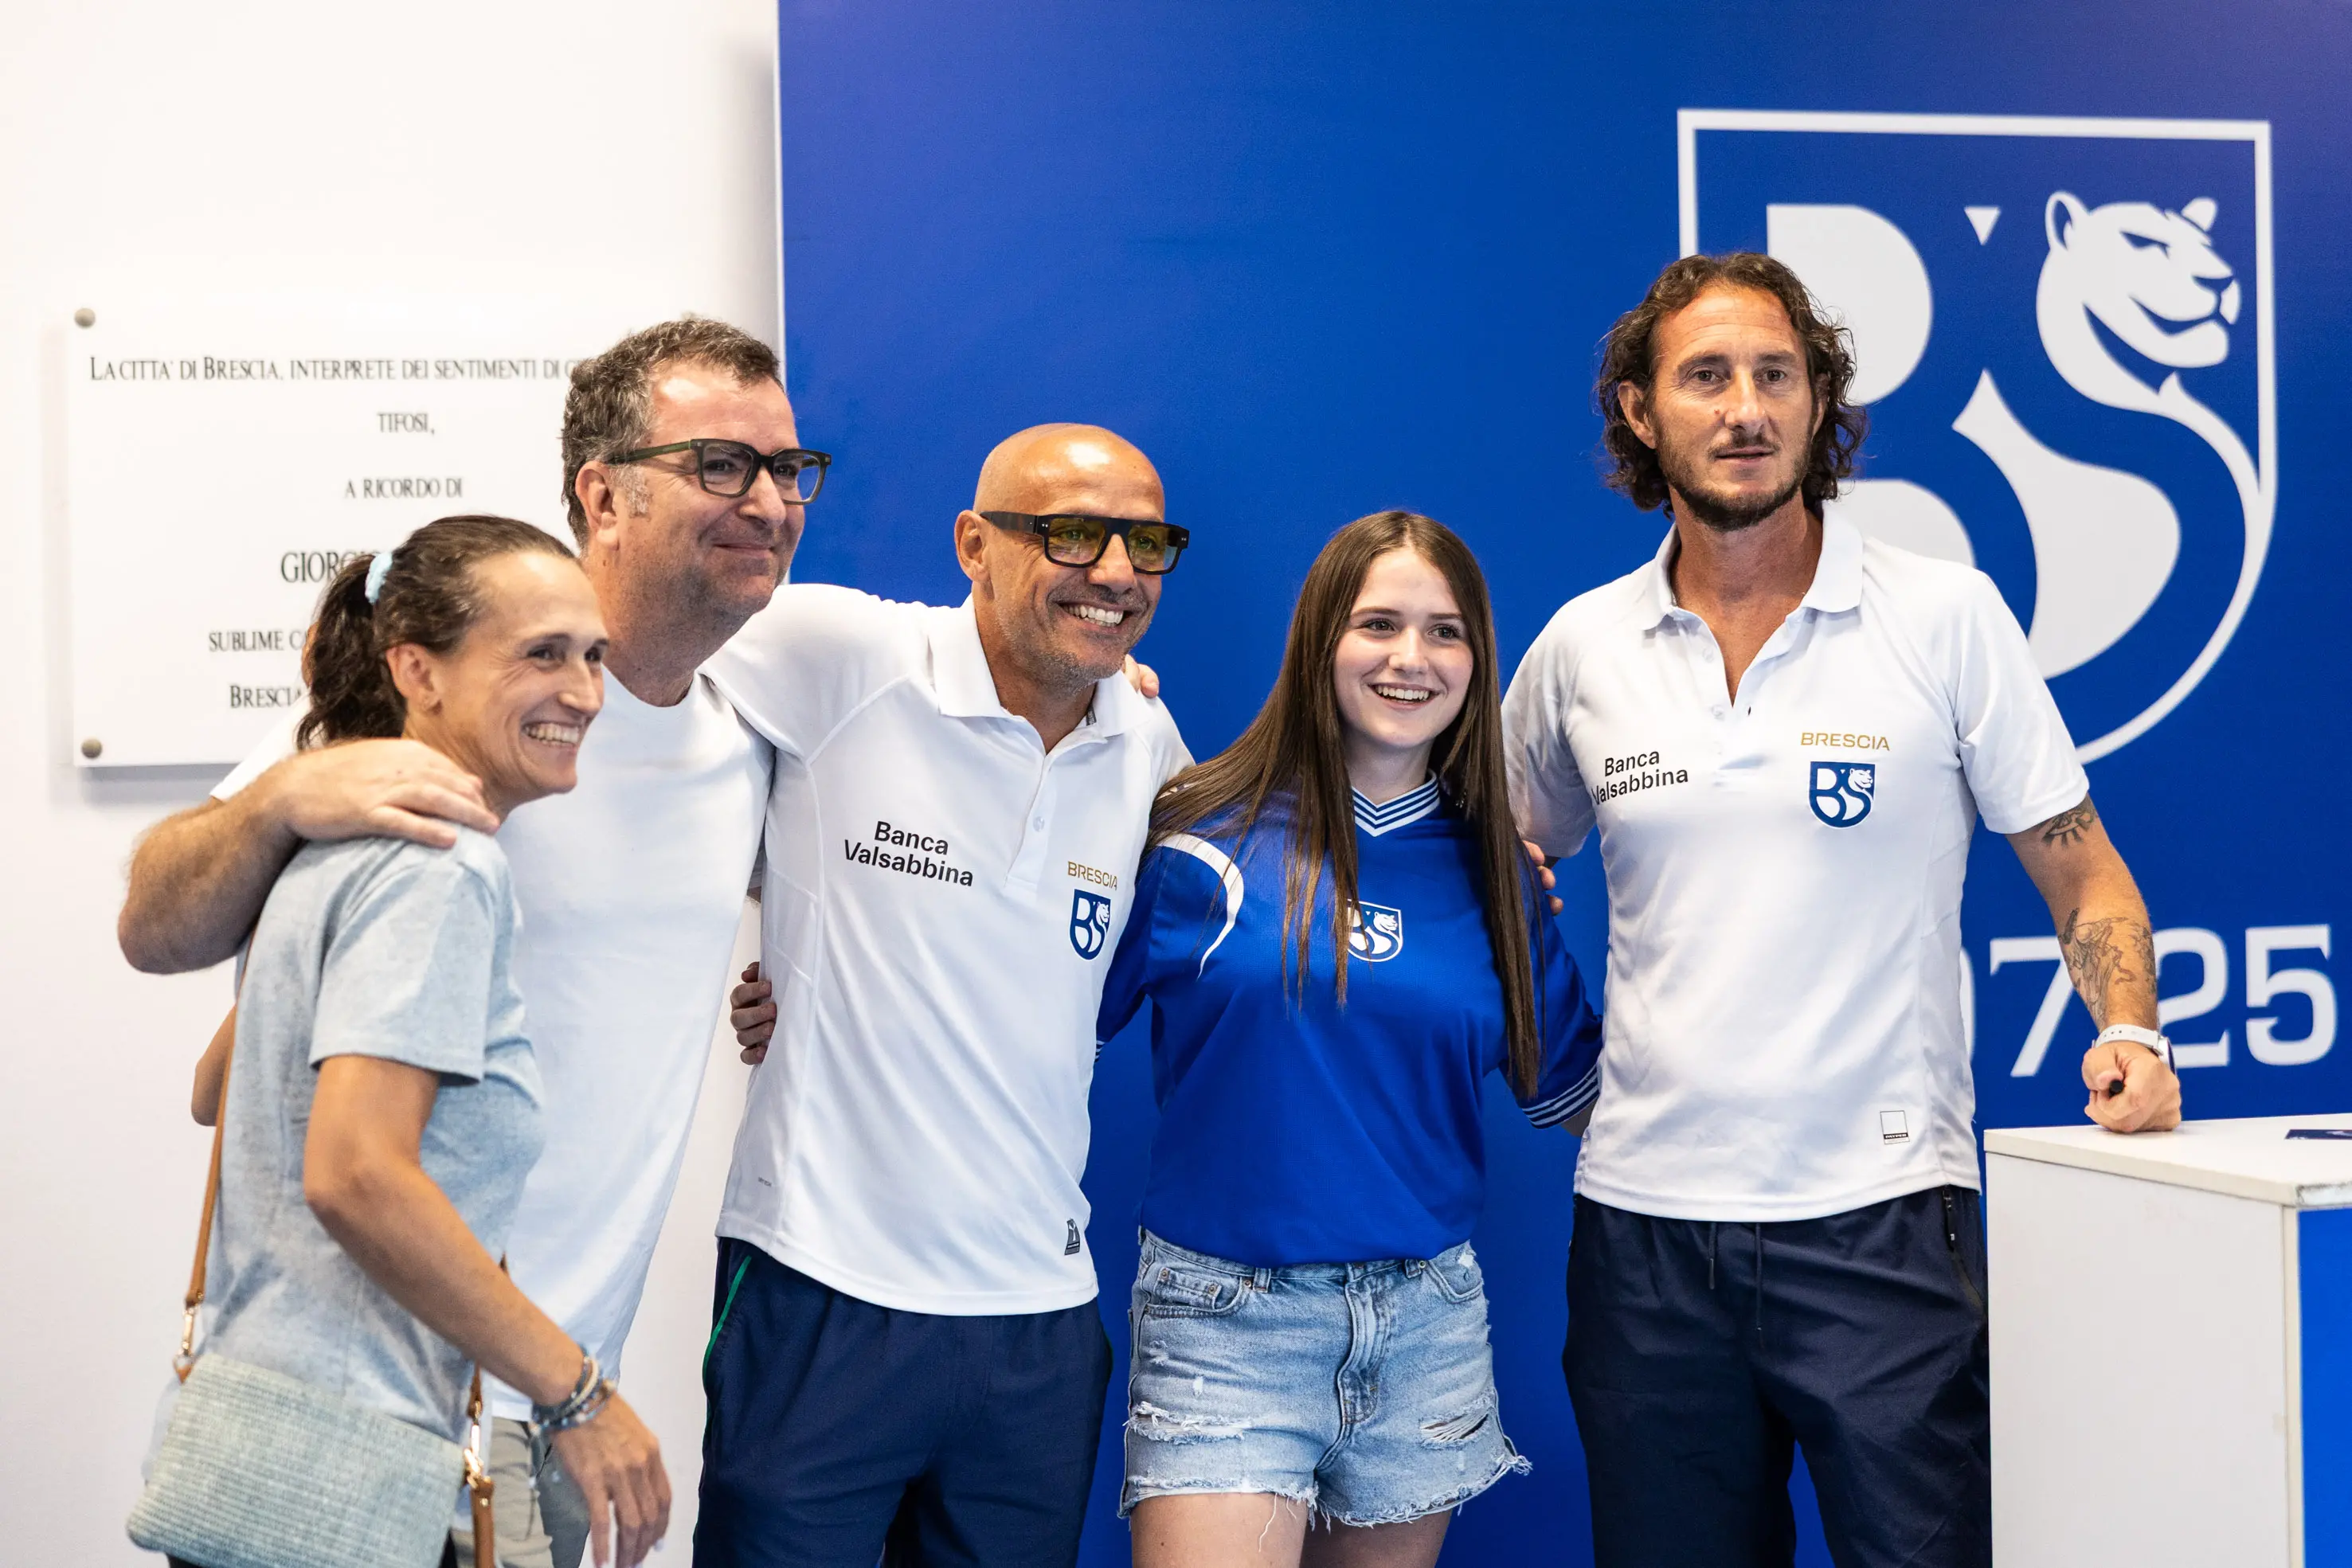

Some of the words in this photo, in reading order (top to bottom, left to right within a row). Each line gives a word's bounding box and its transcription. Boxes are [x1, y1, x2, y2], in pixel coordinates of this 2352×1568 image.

[90, 356, 116, 380] LA
[180, 360, 197, 380] DI
[290, 359, 396, 380] INTERPRETE
[401, 360, 429, 380] DEI
[434, 360, 536, 380] SENTIMENTI
[543, 359, 560, 380] DI
[377, 412, 435, 436] TIFOSI,
[344, 480, 356, 499] A
[363, 479, 441, 499] RICORDO
[446, 478, 463, 498] DI
[209, 632, 284, 652] SUBLIME
[1800, 732, 1891, 751] BRESCIA
[1604, 750, 1660, 777] Banca
[1591, 768, 1689, 806] Valsabbina
[875, 821, 949, 855] Banca
[844, 839, 973, 886] Valsabbina
[1067, 861, 1117, 890] BRESCIA
